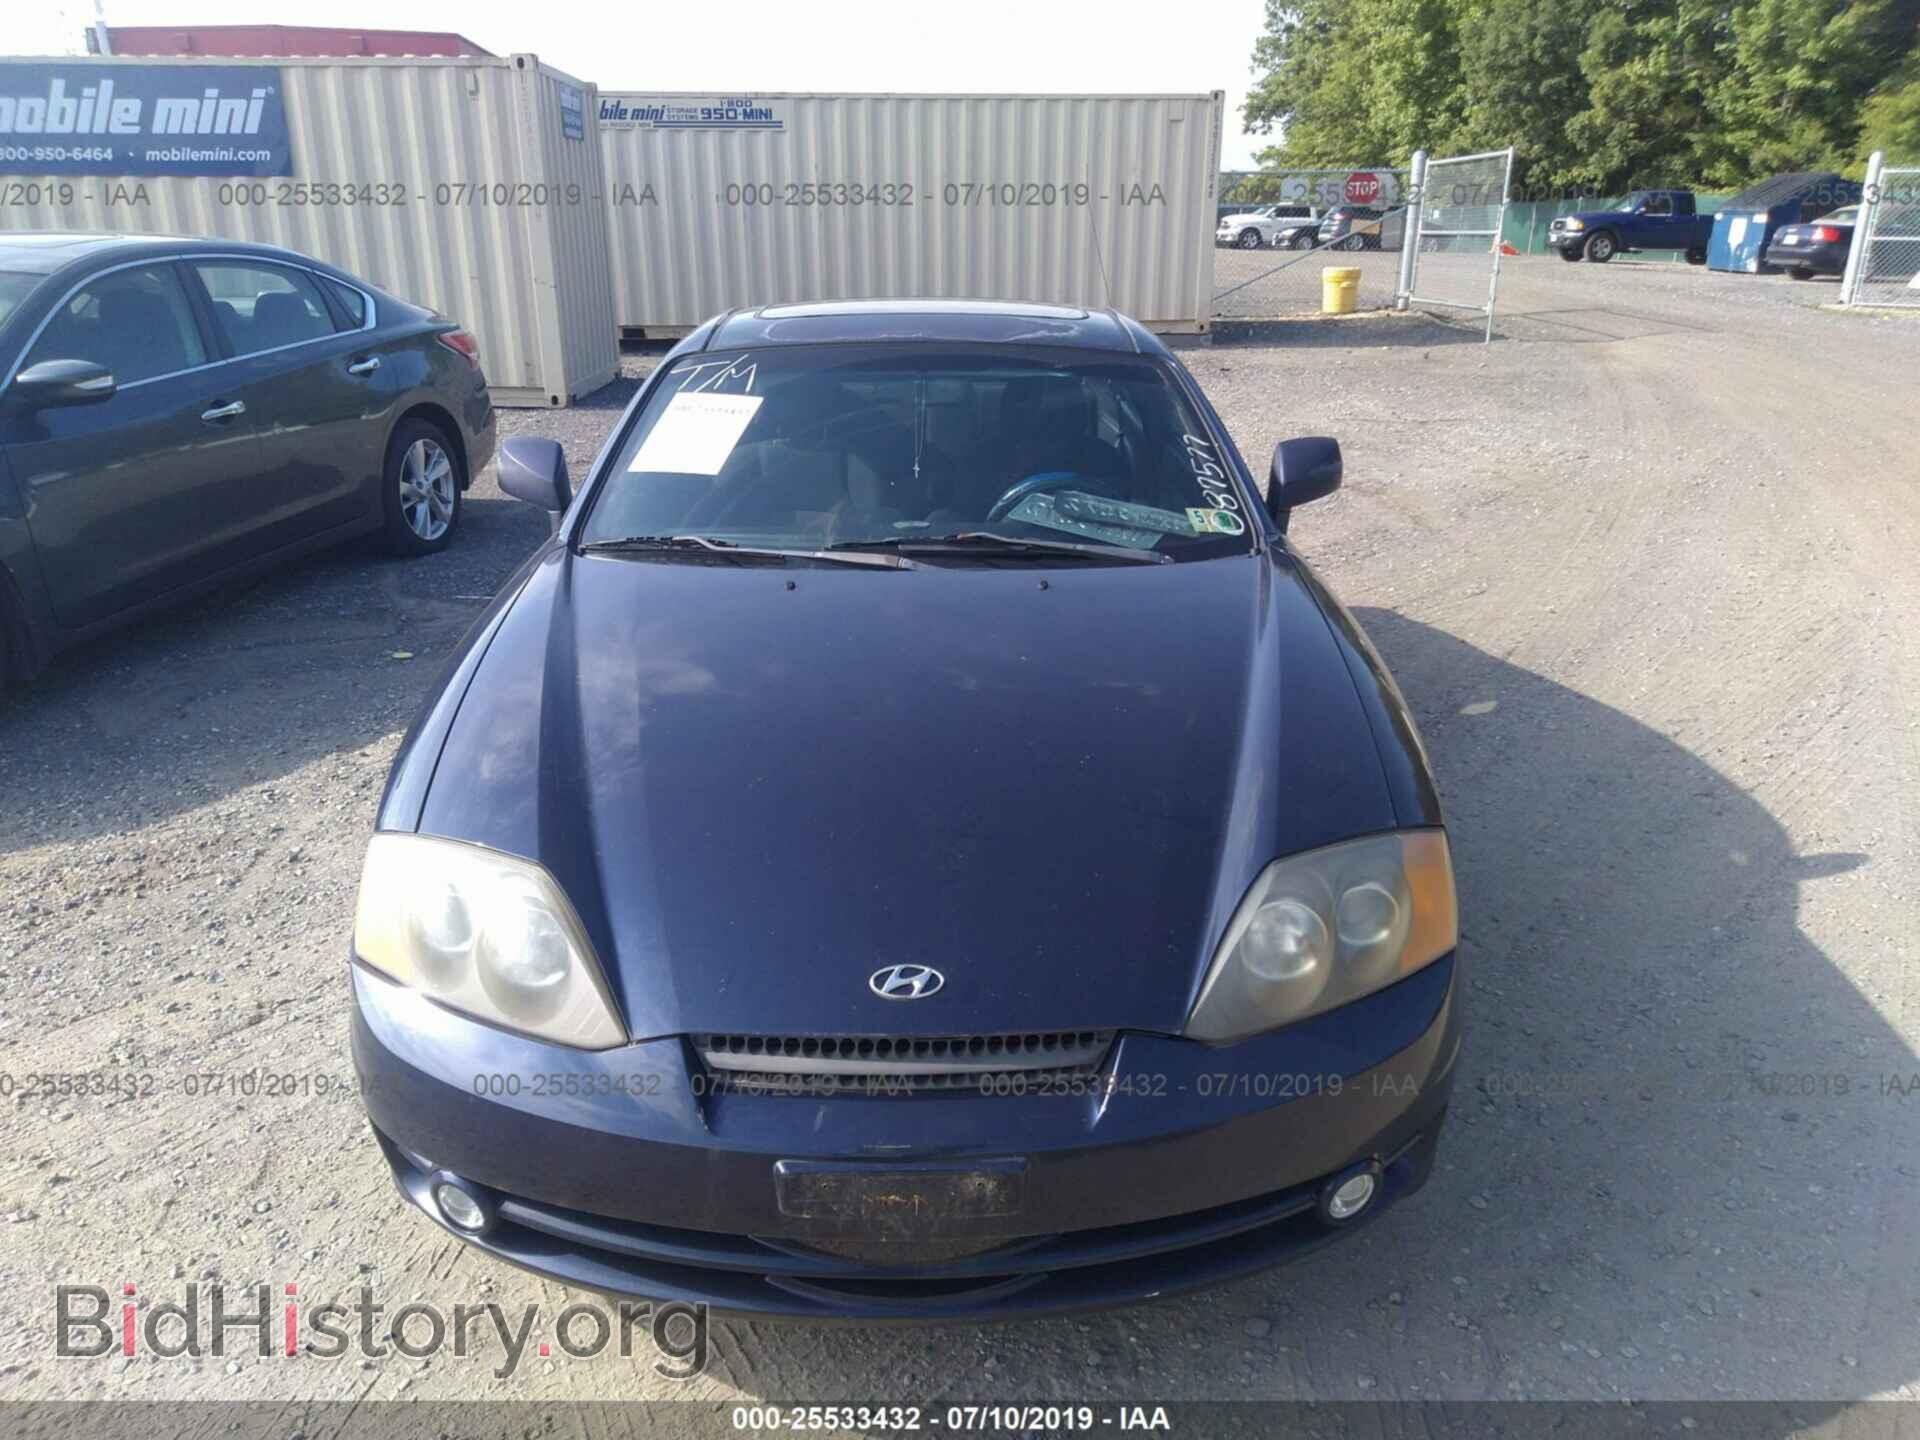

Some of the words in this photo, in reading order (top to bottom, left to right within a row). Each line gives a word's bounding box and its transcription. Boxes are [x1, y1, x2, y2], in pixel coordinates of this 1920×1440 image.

[152, 88, 266, 134] mini
[600, 100, 627, 120] bile
[631, 105, 665, 120] mini
[146, 147, 271, 161] mobilemini.com
[1347, 181, 1377, 196] STOP
[1183, 434, 1244, 535] 087577
